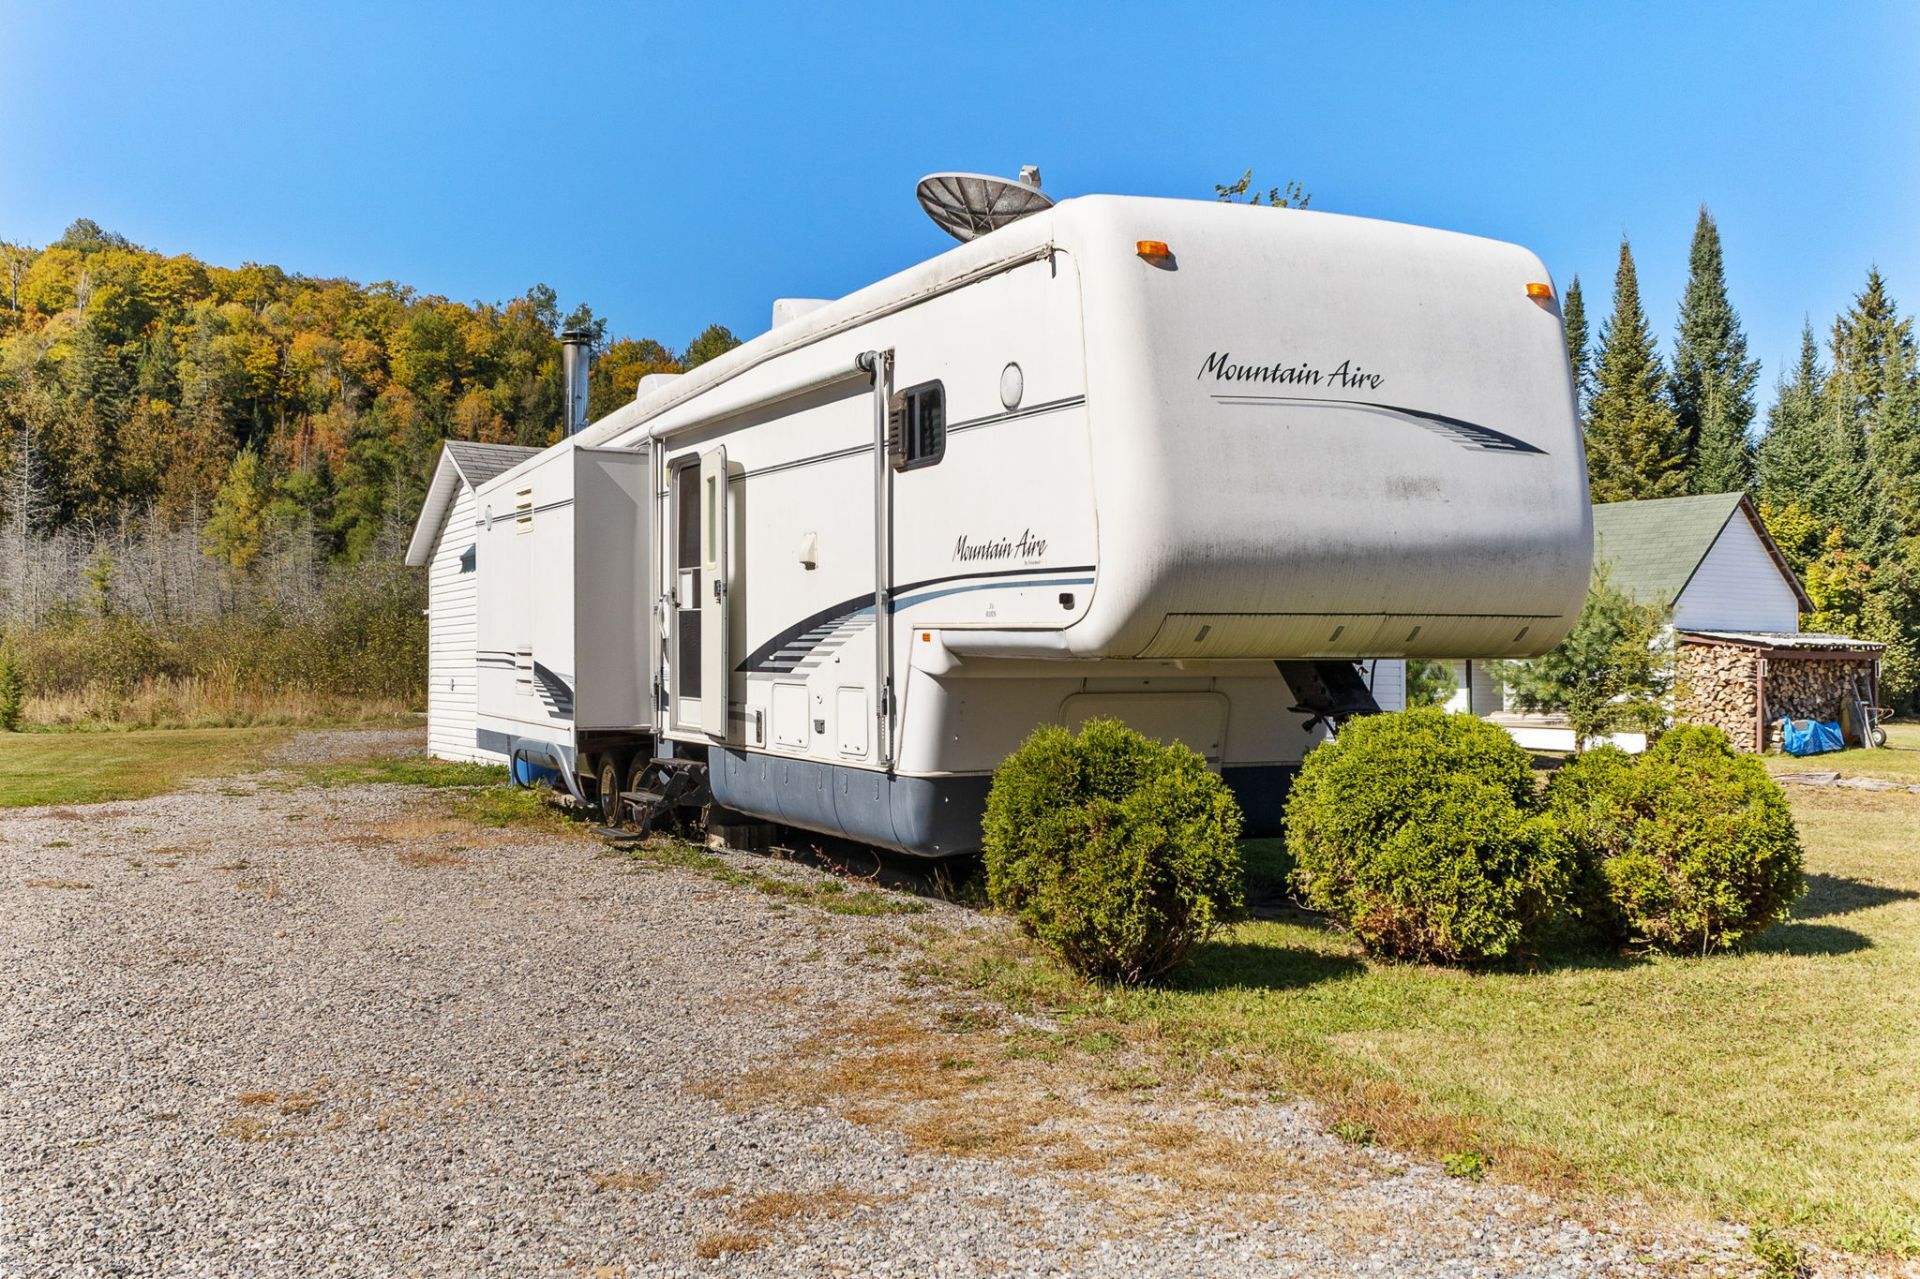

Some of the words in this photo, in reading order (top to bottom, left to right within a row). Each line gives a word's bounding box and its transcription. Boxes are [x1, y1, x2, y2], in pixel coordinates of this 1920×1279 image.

[1197, 351, 1324, 386] Mountain
[1327, 359, 1385, 390] Aire
[952, 534, 1013, 561] Mountain
[1014, 528, 1048, 559] Aire
